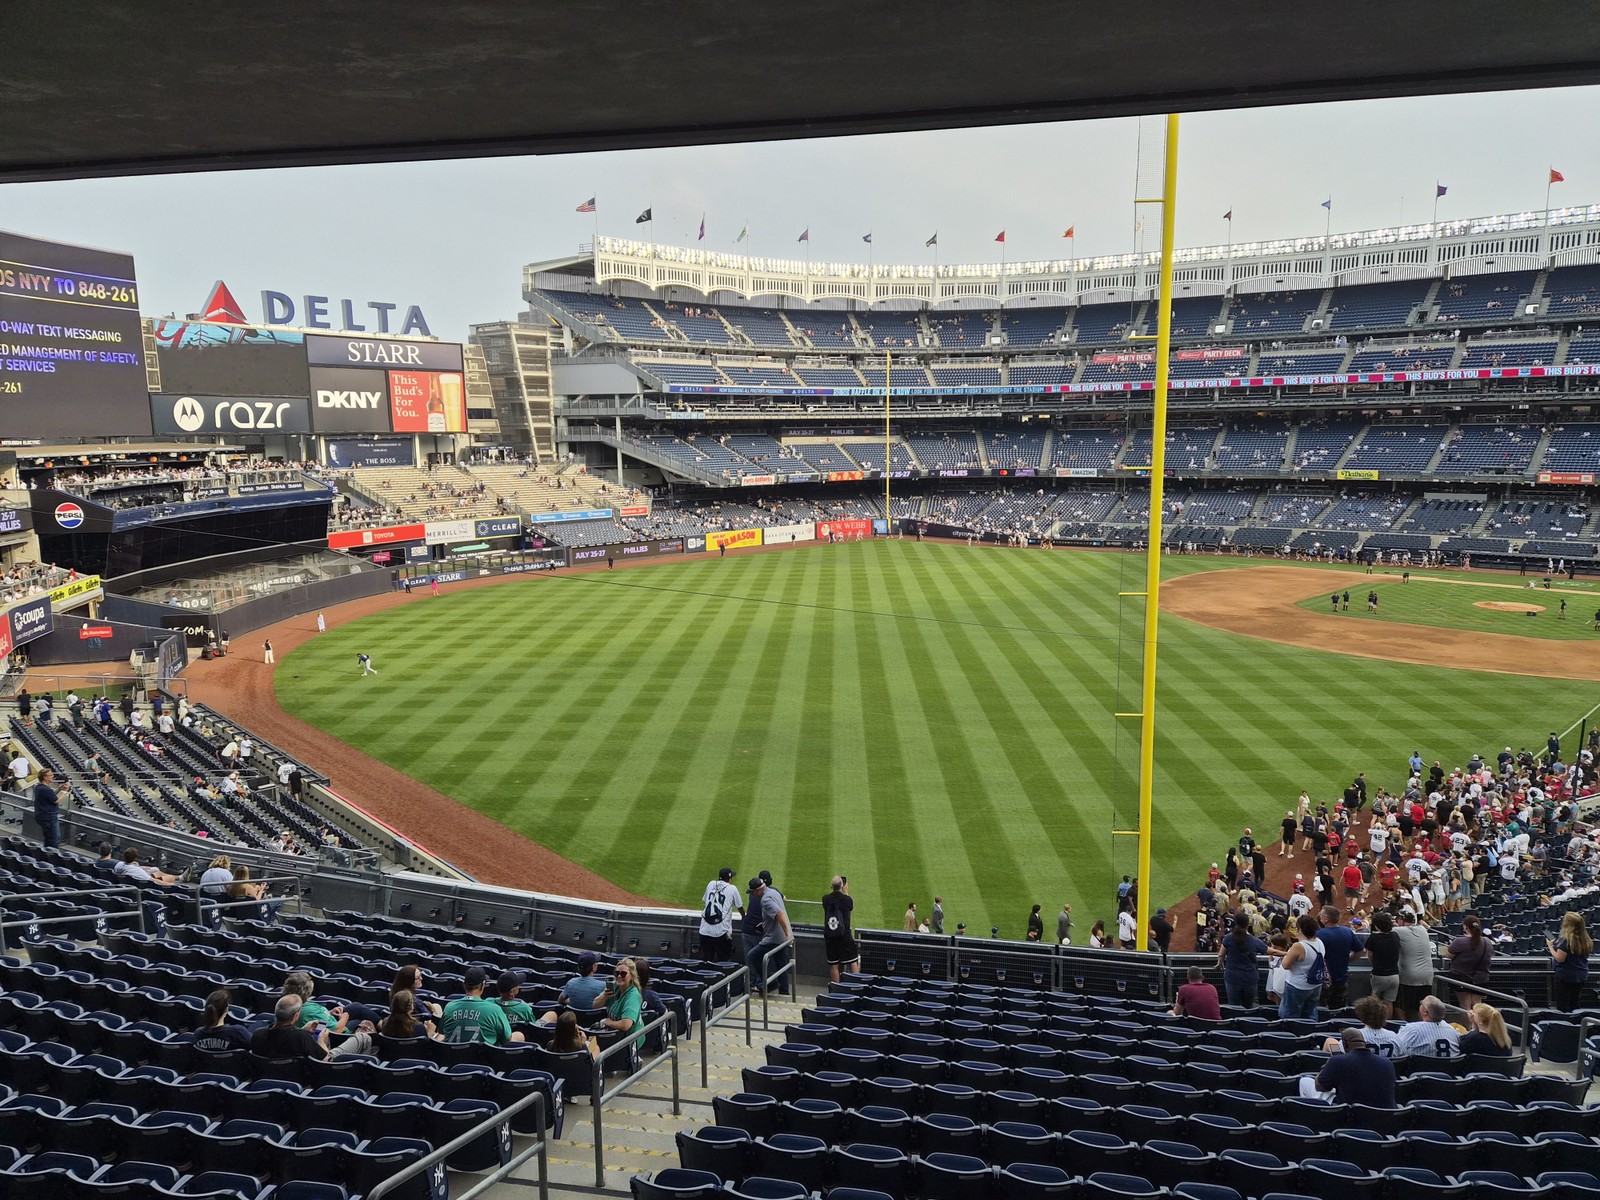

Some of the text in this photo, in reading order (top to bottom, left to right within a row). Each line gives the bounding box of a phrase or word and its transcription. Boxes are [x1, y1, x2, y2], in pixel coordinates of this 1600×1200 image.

[19, 272, 50, 292] NYY
[54, 278, 74, 295] TO
[78, 281, 136, 303] 848-261
[261, 290, 431, 336] DELTA
[36, 324, 62, 338] TEXT
[64, 328, 122, 342] MESSAGING
[12, 345, 82, 360] MANAGEMENT
[84, 350, 98, 362] OF
[100, 352, 138, 366] SAFETY,
[348, 342, 422, 364] STARR
[6, 360, 56, 373] SERVICES
[1564, 366, 1589, 375] BUD'S
[392, 374, 418, 385] This
[0, 382, 22, 394] -261
[394, 385, 423, 396] Bud's
[316, 390, 382, 408] DKNY
[395, 397, 413, 406] For
[215, 402, 290, 428] razr
[395, 406, 419, 417] You.
[1, 511, 16, 520] 25-27
[624, 546, 648, 554] PHILLIES
[524, 563, 544, 571] StubHub
[438, 573, 461, 582] STARR
[68, 584, 83, 595] Gillette
[86, 579, 99, 590] Gillette
[22, 607, 44, 624] coupa
[453, 1010, 480, 1020] BRASH
[449, 1026, 480, 1043] 47
[1435, 1039, 1450, 1057] 8
